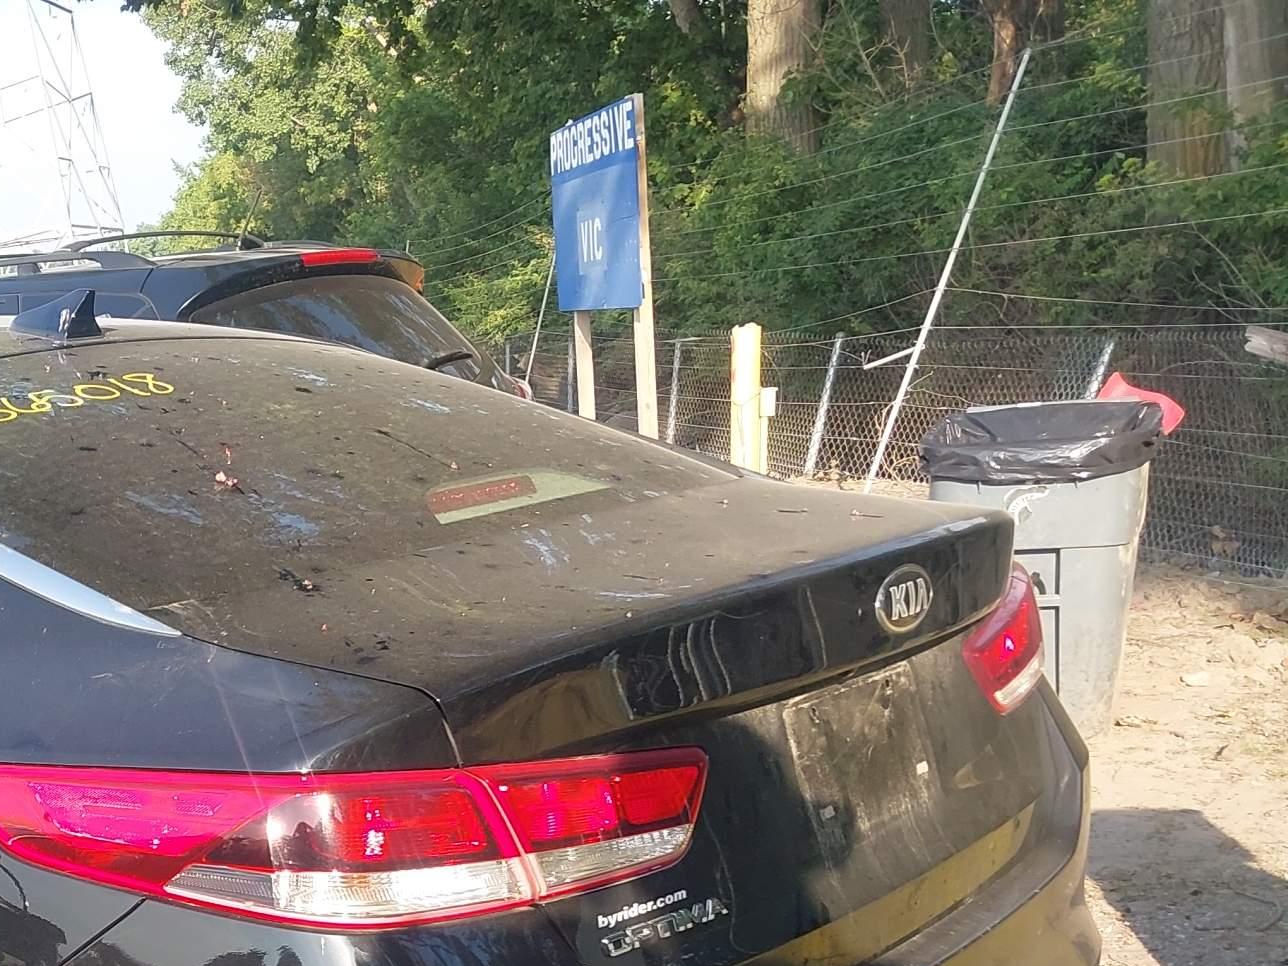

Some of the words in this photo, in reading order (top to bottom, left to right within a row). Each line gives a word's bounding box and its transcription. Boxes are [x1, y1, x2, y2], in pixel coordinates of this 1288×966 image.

[549, 100, 635, 176] PROGRESSIVE
[579, 217, 604, 263] VIC
[888, 577, 929, 621] KIA
[597, 889, 688, 929] byrider.com
[600, 897, 729, 958] OPTIMA
